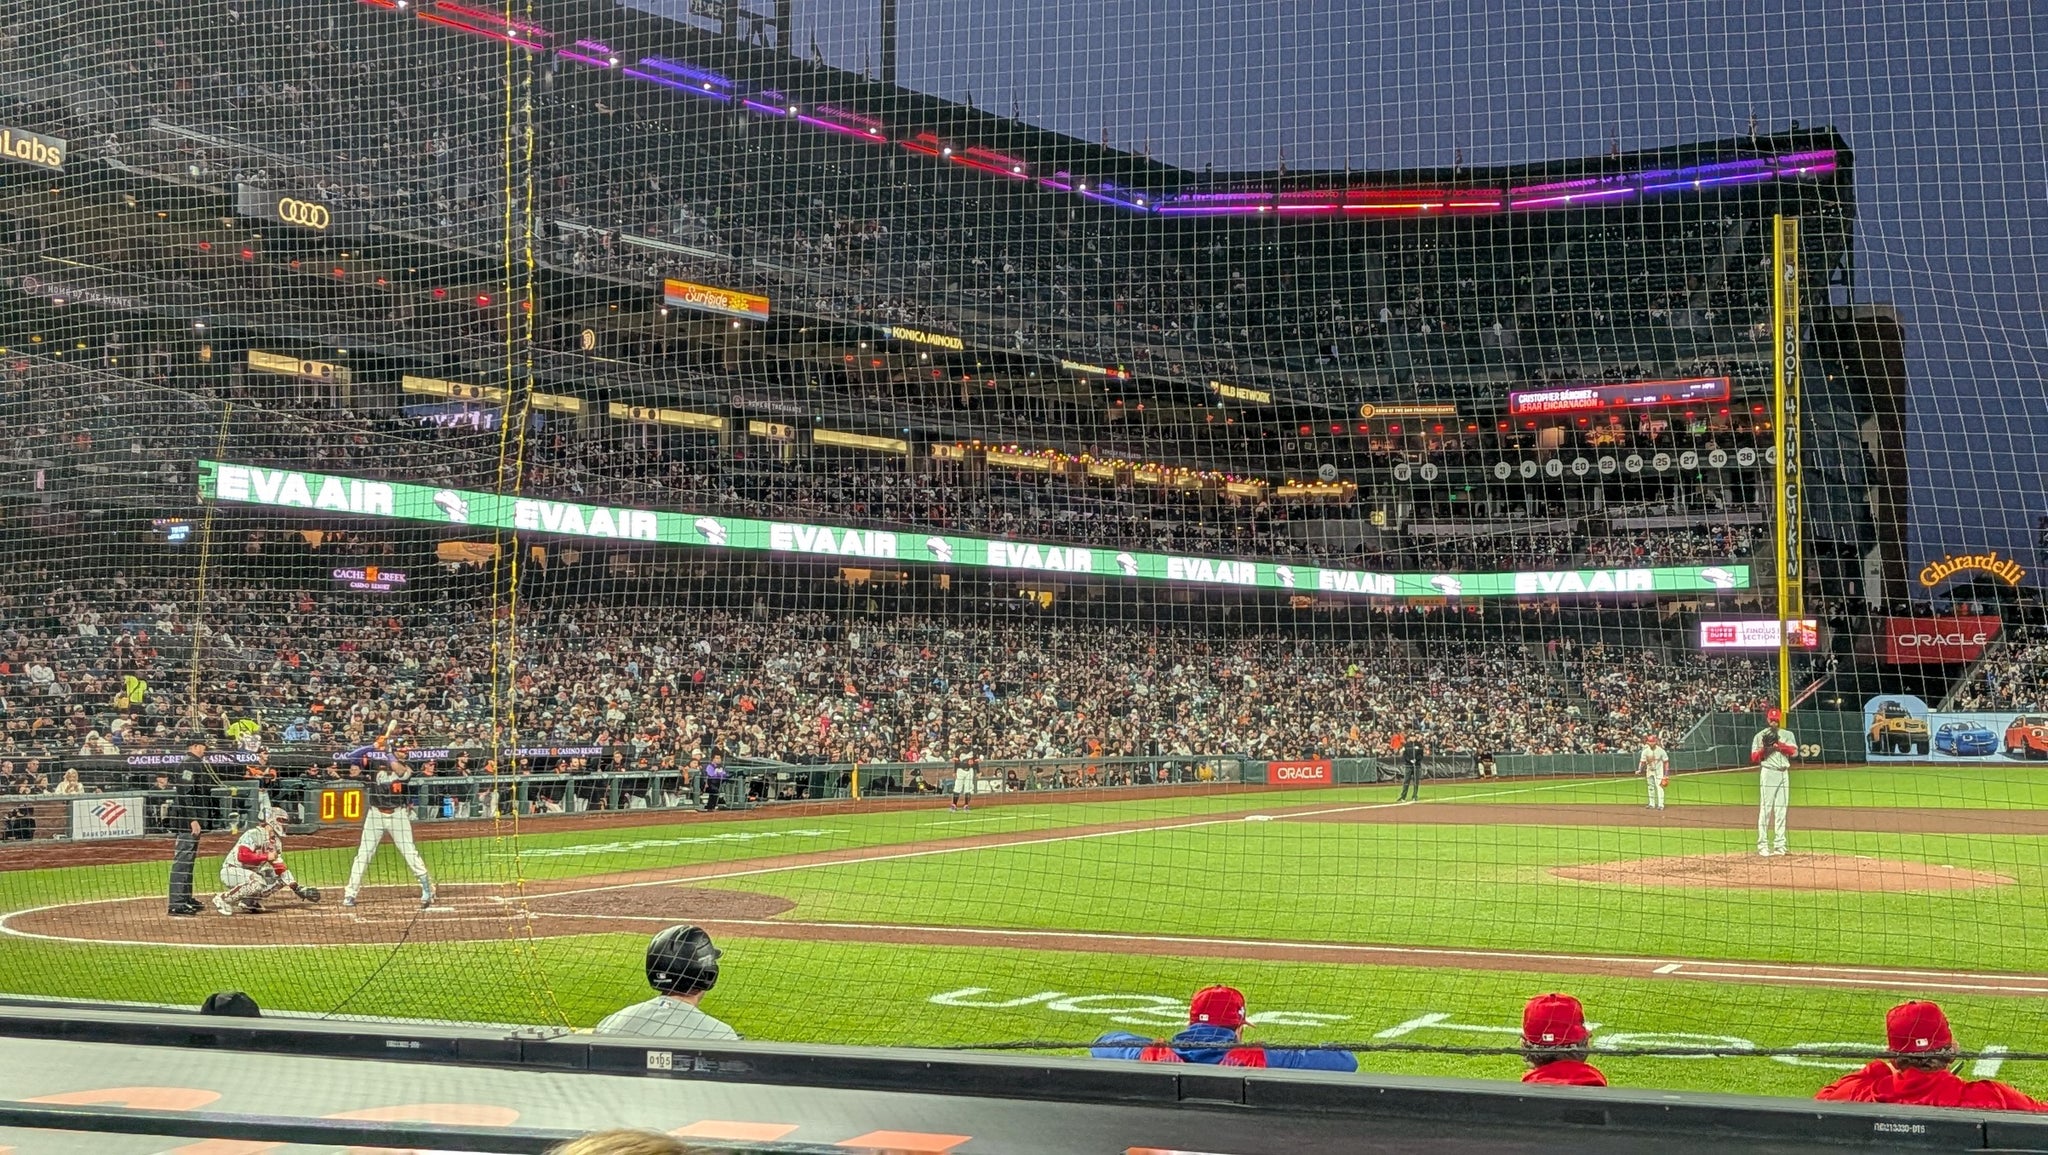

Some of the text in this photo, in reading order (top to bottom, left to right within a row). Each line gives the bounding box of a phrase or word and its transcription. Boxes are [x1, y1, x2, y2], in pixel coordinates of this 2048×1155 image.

[0, 131, 61, 166] Labs
[685, 285, 728, 307] Surfside
[892, 326, 964, 350] KONICA MINOLTA
[1785, 325, 1797, 385] ROOT
[1220, 384, 1271, 404] MLB NETWORK
[1785, 398, 1797, 414] 4
[1712, 454, 1724, 463] 30
[1785, 426, 1798, 475] THA
[1524, 465, 1531, 474] 4
[1550, 463, 1558, 472] 11
[1601, 461, 1613, 469] 22
[1628, 459, 1640, 467] 24
[1655, 457, 1667, 467] 25
[1683, 456, 1694, 465] 27
[1321, 468, 1334, 477] 42
[216, 464, 393, 515] EVAAIR
[514, 500, 658, 541] EVAAIR
[770, 522, 896, 558] EVAAIR
[1785, 485, 1799, 577] CHIKIN
[987, 540, 1093, 573] EVAAIR
[333, 568, 407, 583] CACHE CREEK
[1167, 557, 1257, 585] EVAAIR
[1919, 551, 2027, 588] Ghirardelli
[1318, 569, 1396, 595] EVAAIR
[1514, 568, 1652, 595] EVAAIR
[1899, 632, 1988, 647] ORACLE
[127, 755, 161, 765] CACHE
[161, 754, 185, 764] CRE
[423, 750, 450, 759] RESORT
[529, 747, 551, 756] CREEK
[557, 747, 581, 755] CASINO
[581, 746, 603, 755] RESORT
[1277, 766, 1324, 780] ORACLE
